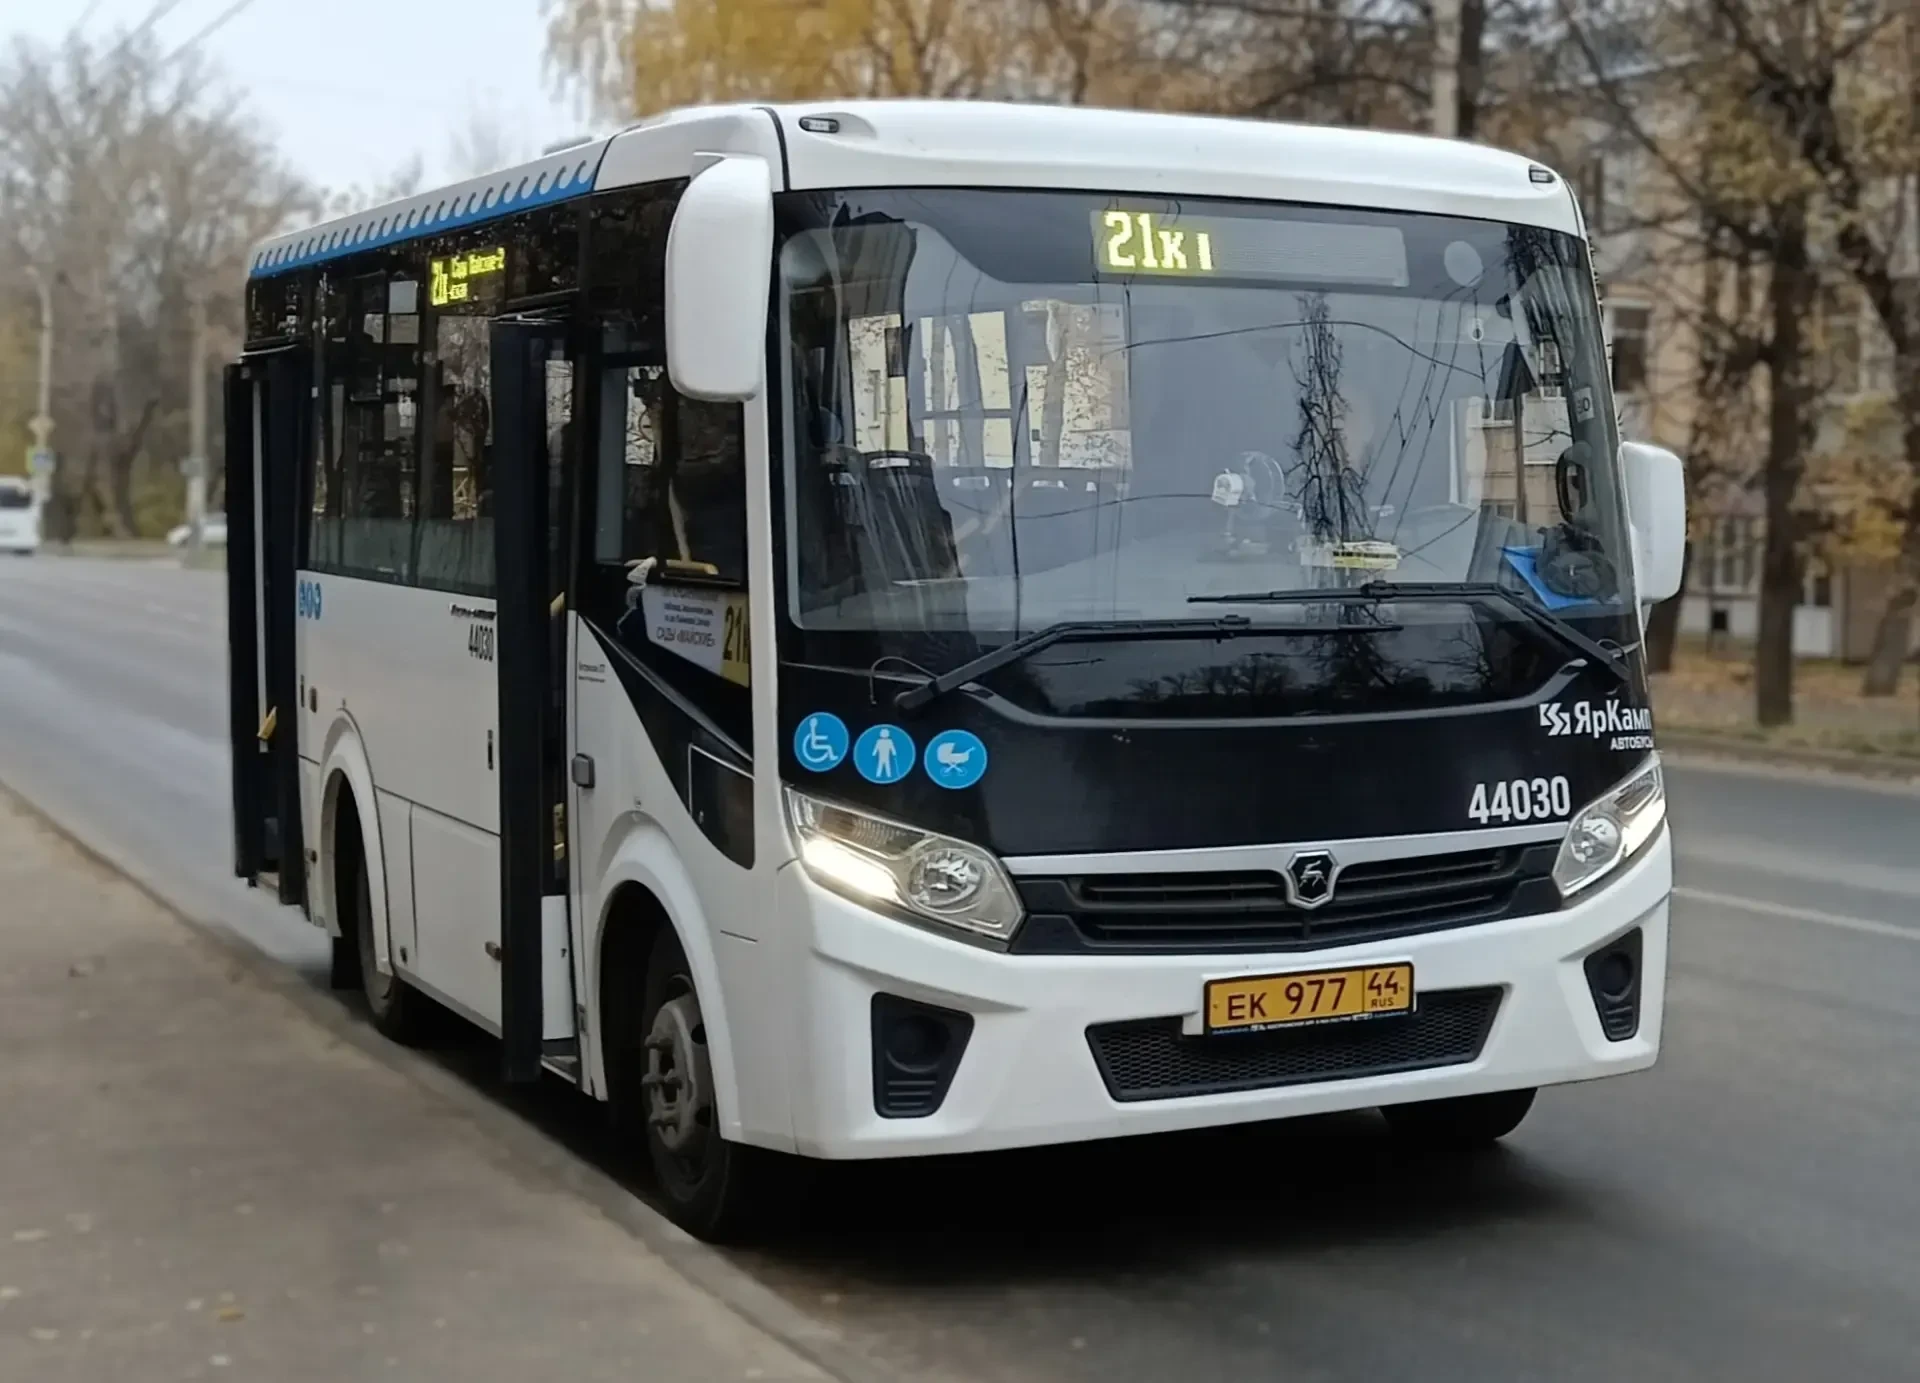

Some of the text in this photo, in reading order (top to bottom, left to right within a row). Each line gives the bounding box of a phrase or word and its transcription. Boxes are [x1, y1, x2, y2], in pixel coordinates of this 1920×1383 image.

[467, 623, 494, 662] 44030
[1468, 775, 1571, 824] 44030
[1284, 977, 1347, 1014] 977
[1367, 970, 1399, 997] 44
[1370, 997, 1394, 1008] RUS
